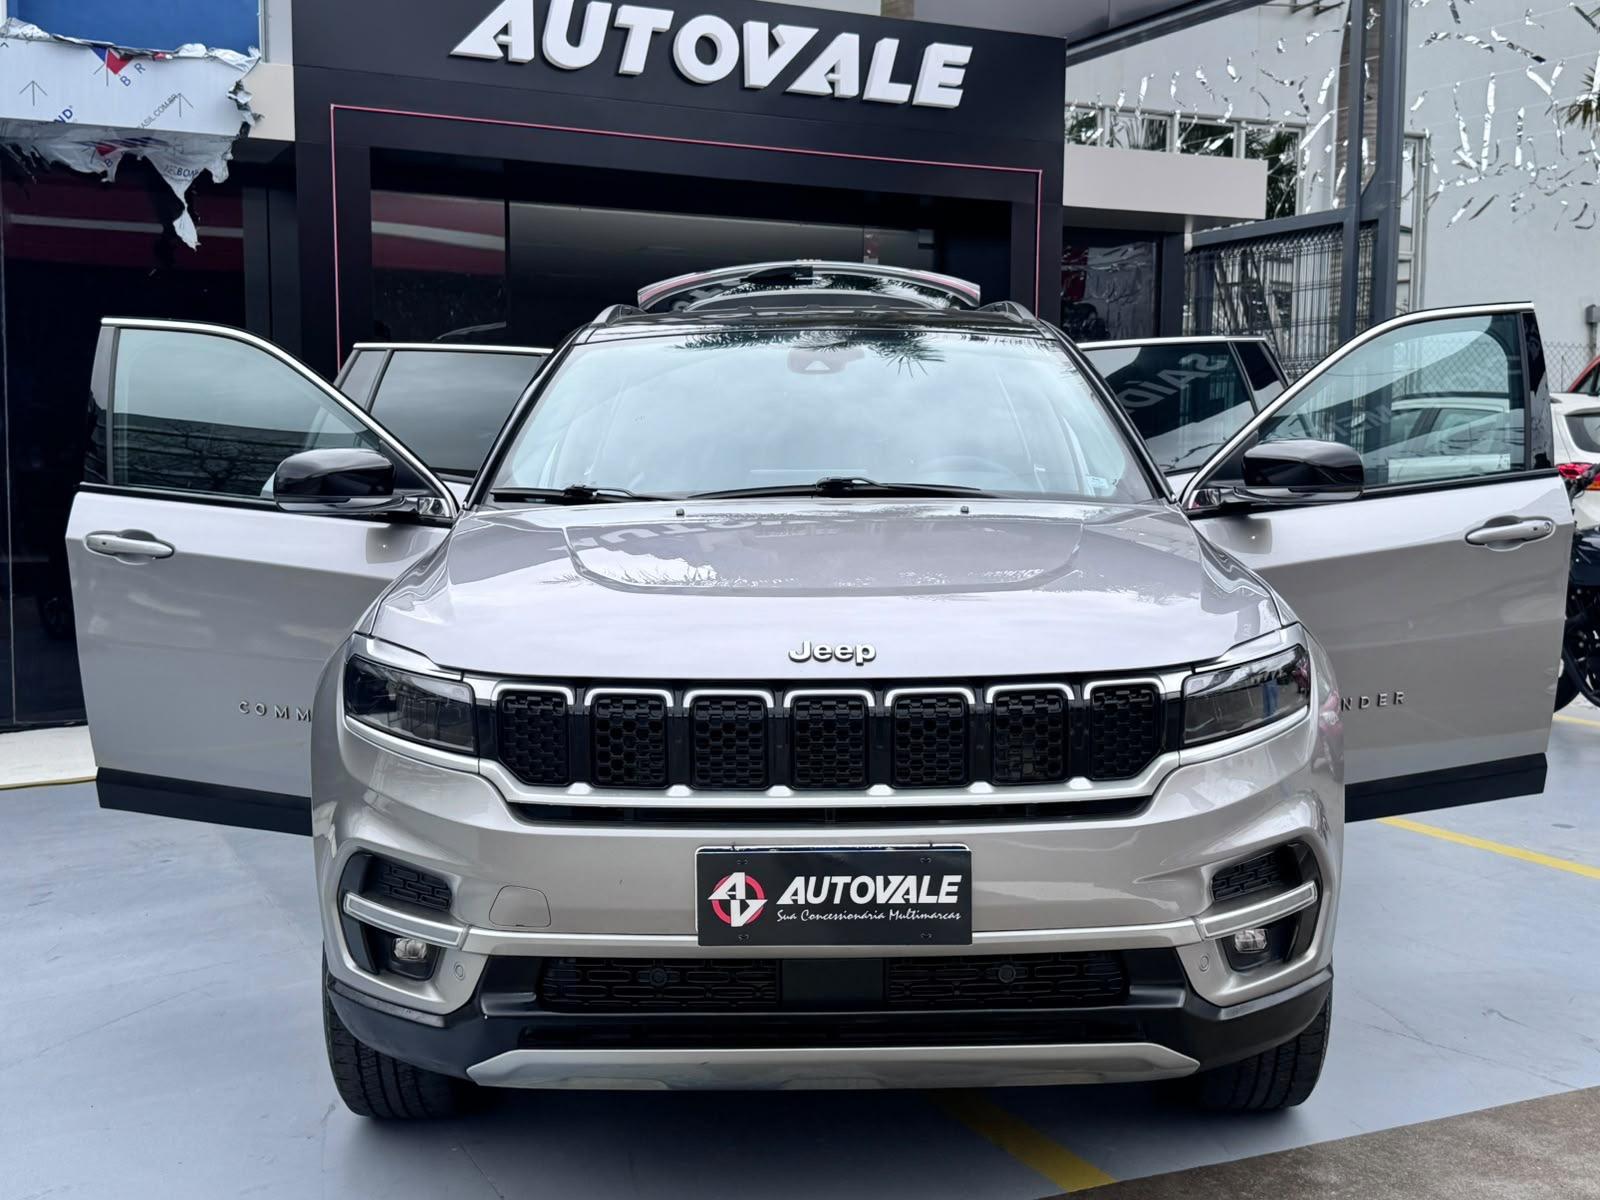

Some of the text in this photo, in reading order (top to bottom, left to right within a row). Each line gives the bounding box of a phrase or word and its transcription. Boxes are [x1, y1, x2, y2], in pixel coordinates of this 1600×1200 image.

[449, 0, 973, 109] AUTOVALE
[788, 639, 877, 667] Jeep
[239, 700, 312, 723] COMM
[1340, 691, 1404, 712] NDER
[776, 874, 962, 905] AUTOVALE
[776, 907, 962, 922] Sua Concessionária Multimarcas
